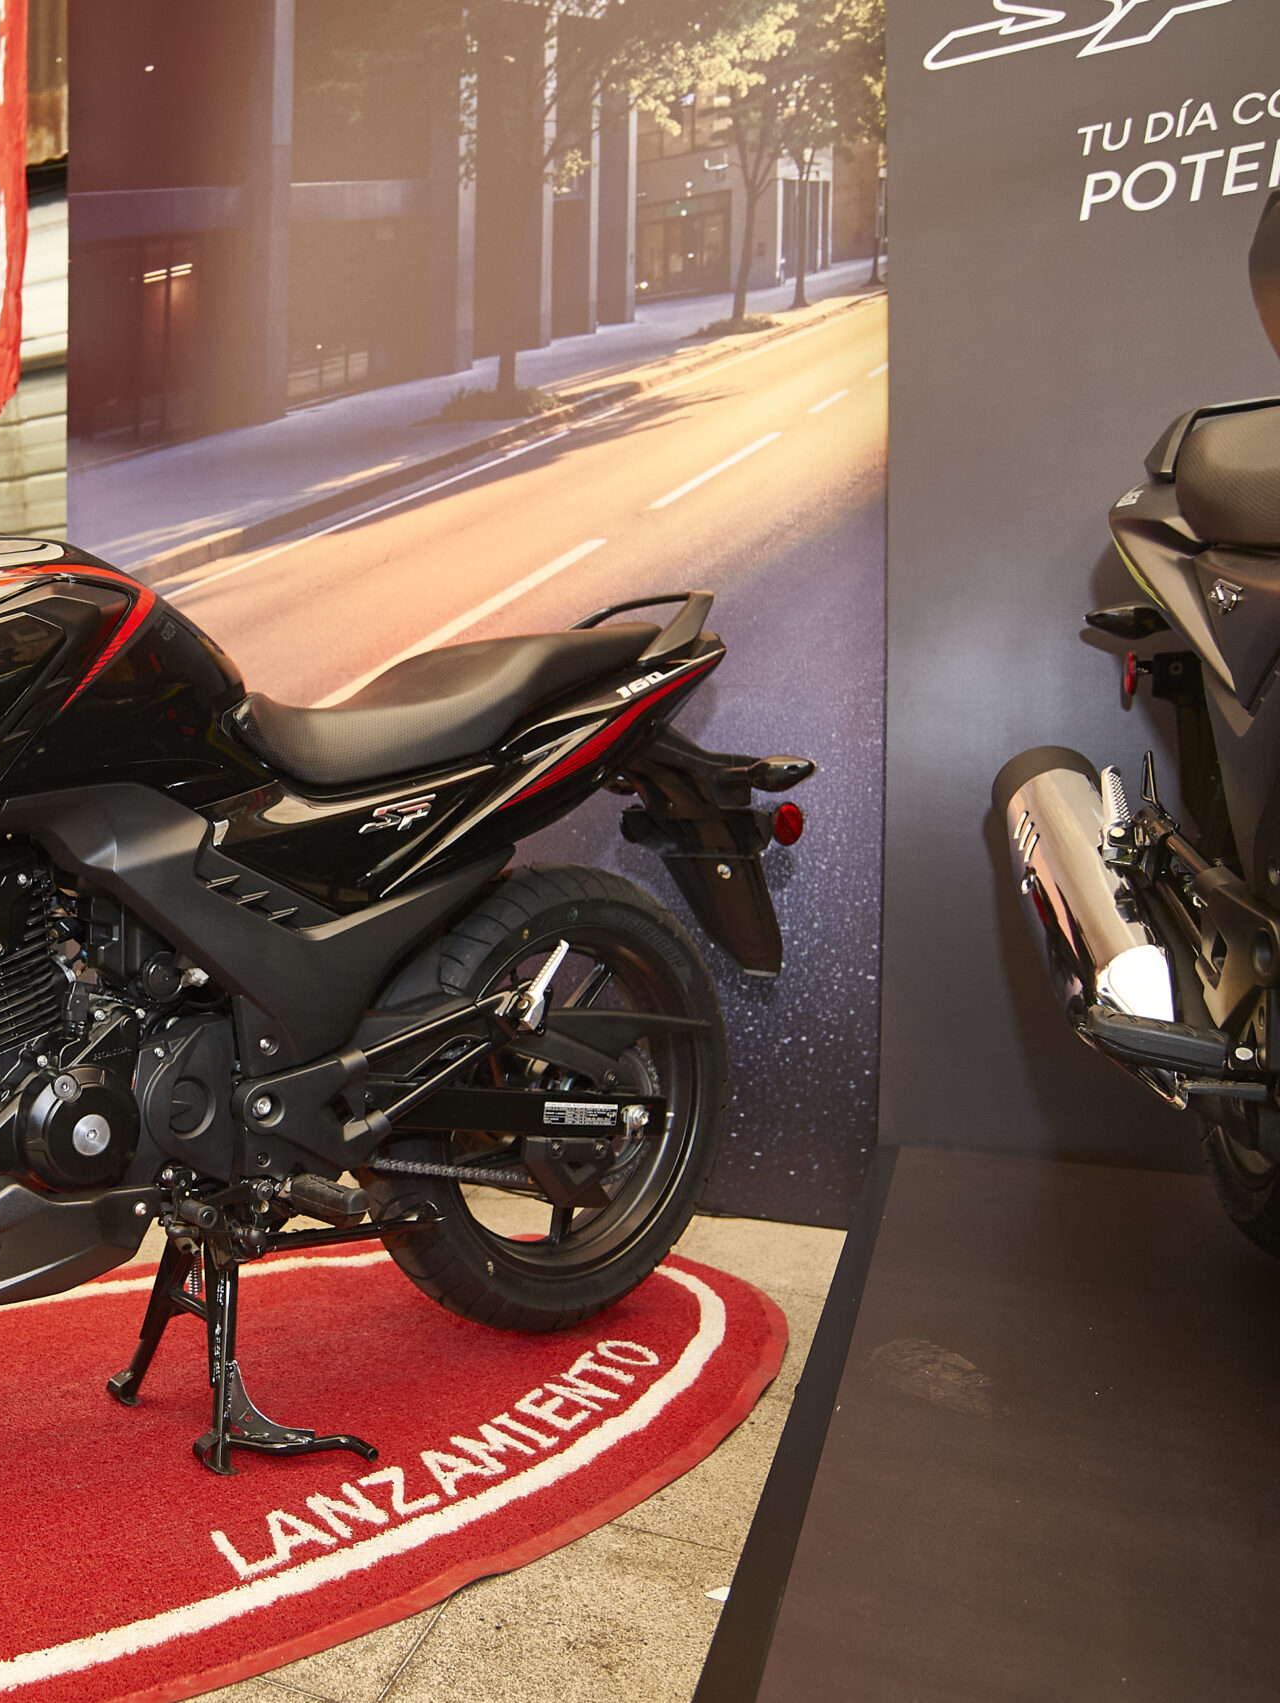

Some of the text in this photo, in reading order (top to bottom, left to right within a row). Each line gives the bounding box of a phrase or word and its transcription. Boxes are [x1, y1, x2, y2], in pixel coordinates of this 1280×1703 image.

[1077, 117, 1132, 156] TU
[1144, 99, 1218, 144] DÍA
[615, 670, 666, 699] 160
[359, 793, 437, 834] SP
[210, 1339, 659, 1578] LANZAMIENTO
